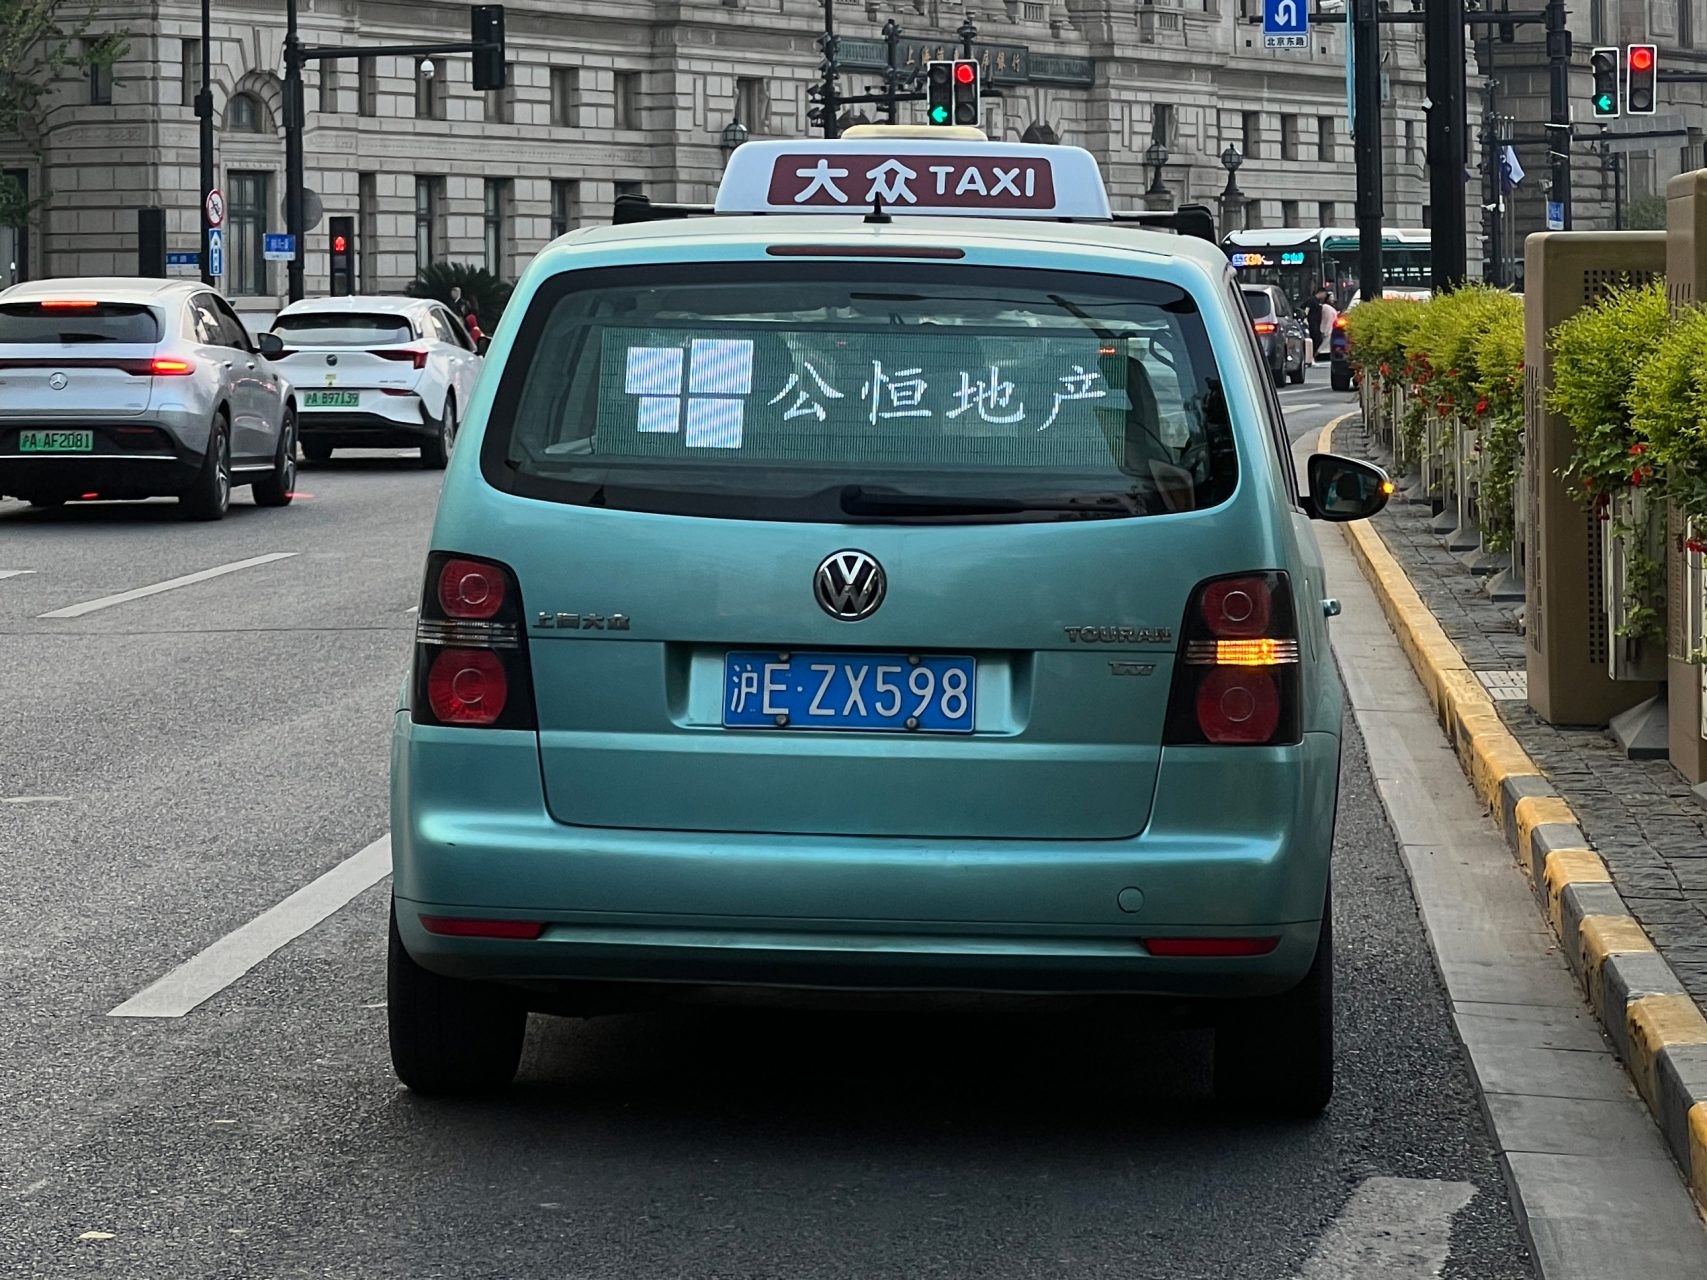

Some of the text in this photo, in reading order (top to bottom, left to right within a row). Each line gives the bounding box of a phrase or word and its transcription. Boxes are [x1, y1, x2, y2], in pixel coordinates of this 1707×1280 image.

[1267, 36, 1304, 46] 北京东路
[794, 158, 1036, 204] 大众 TAXI
[768, 360, 1107, 432] 公恒地产
